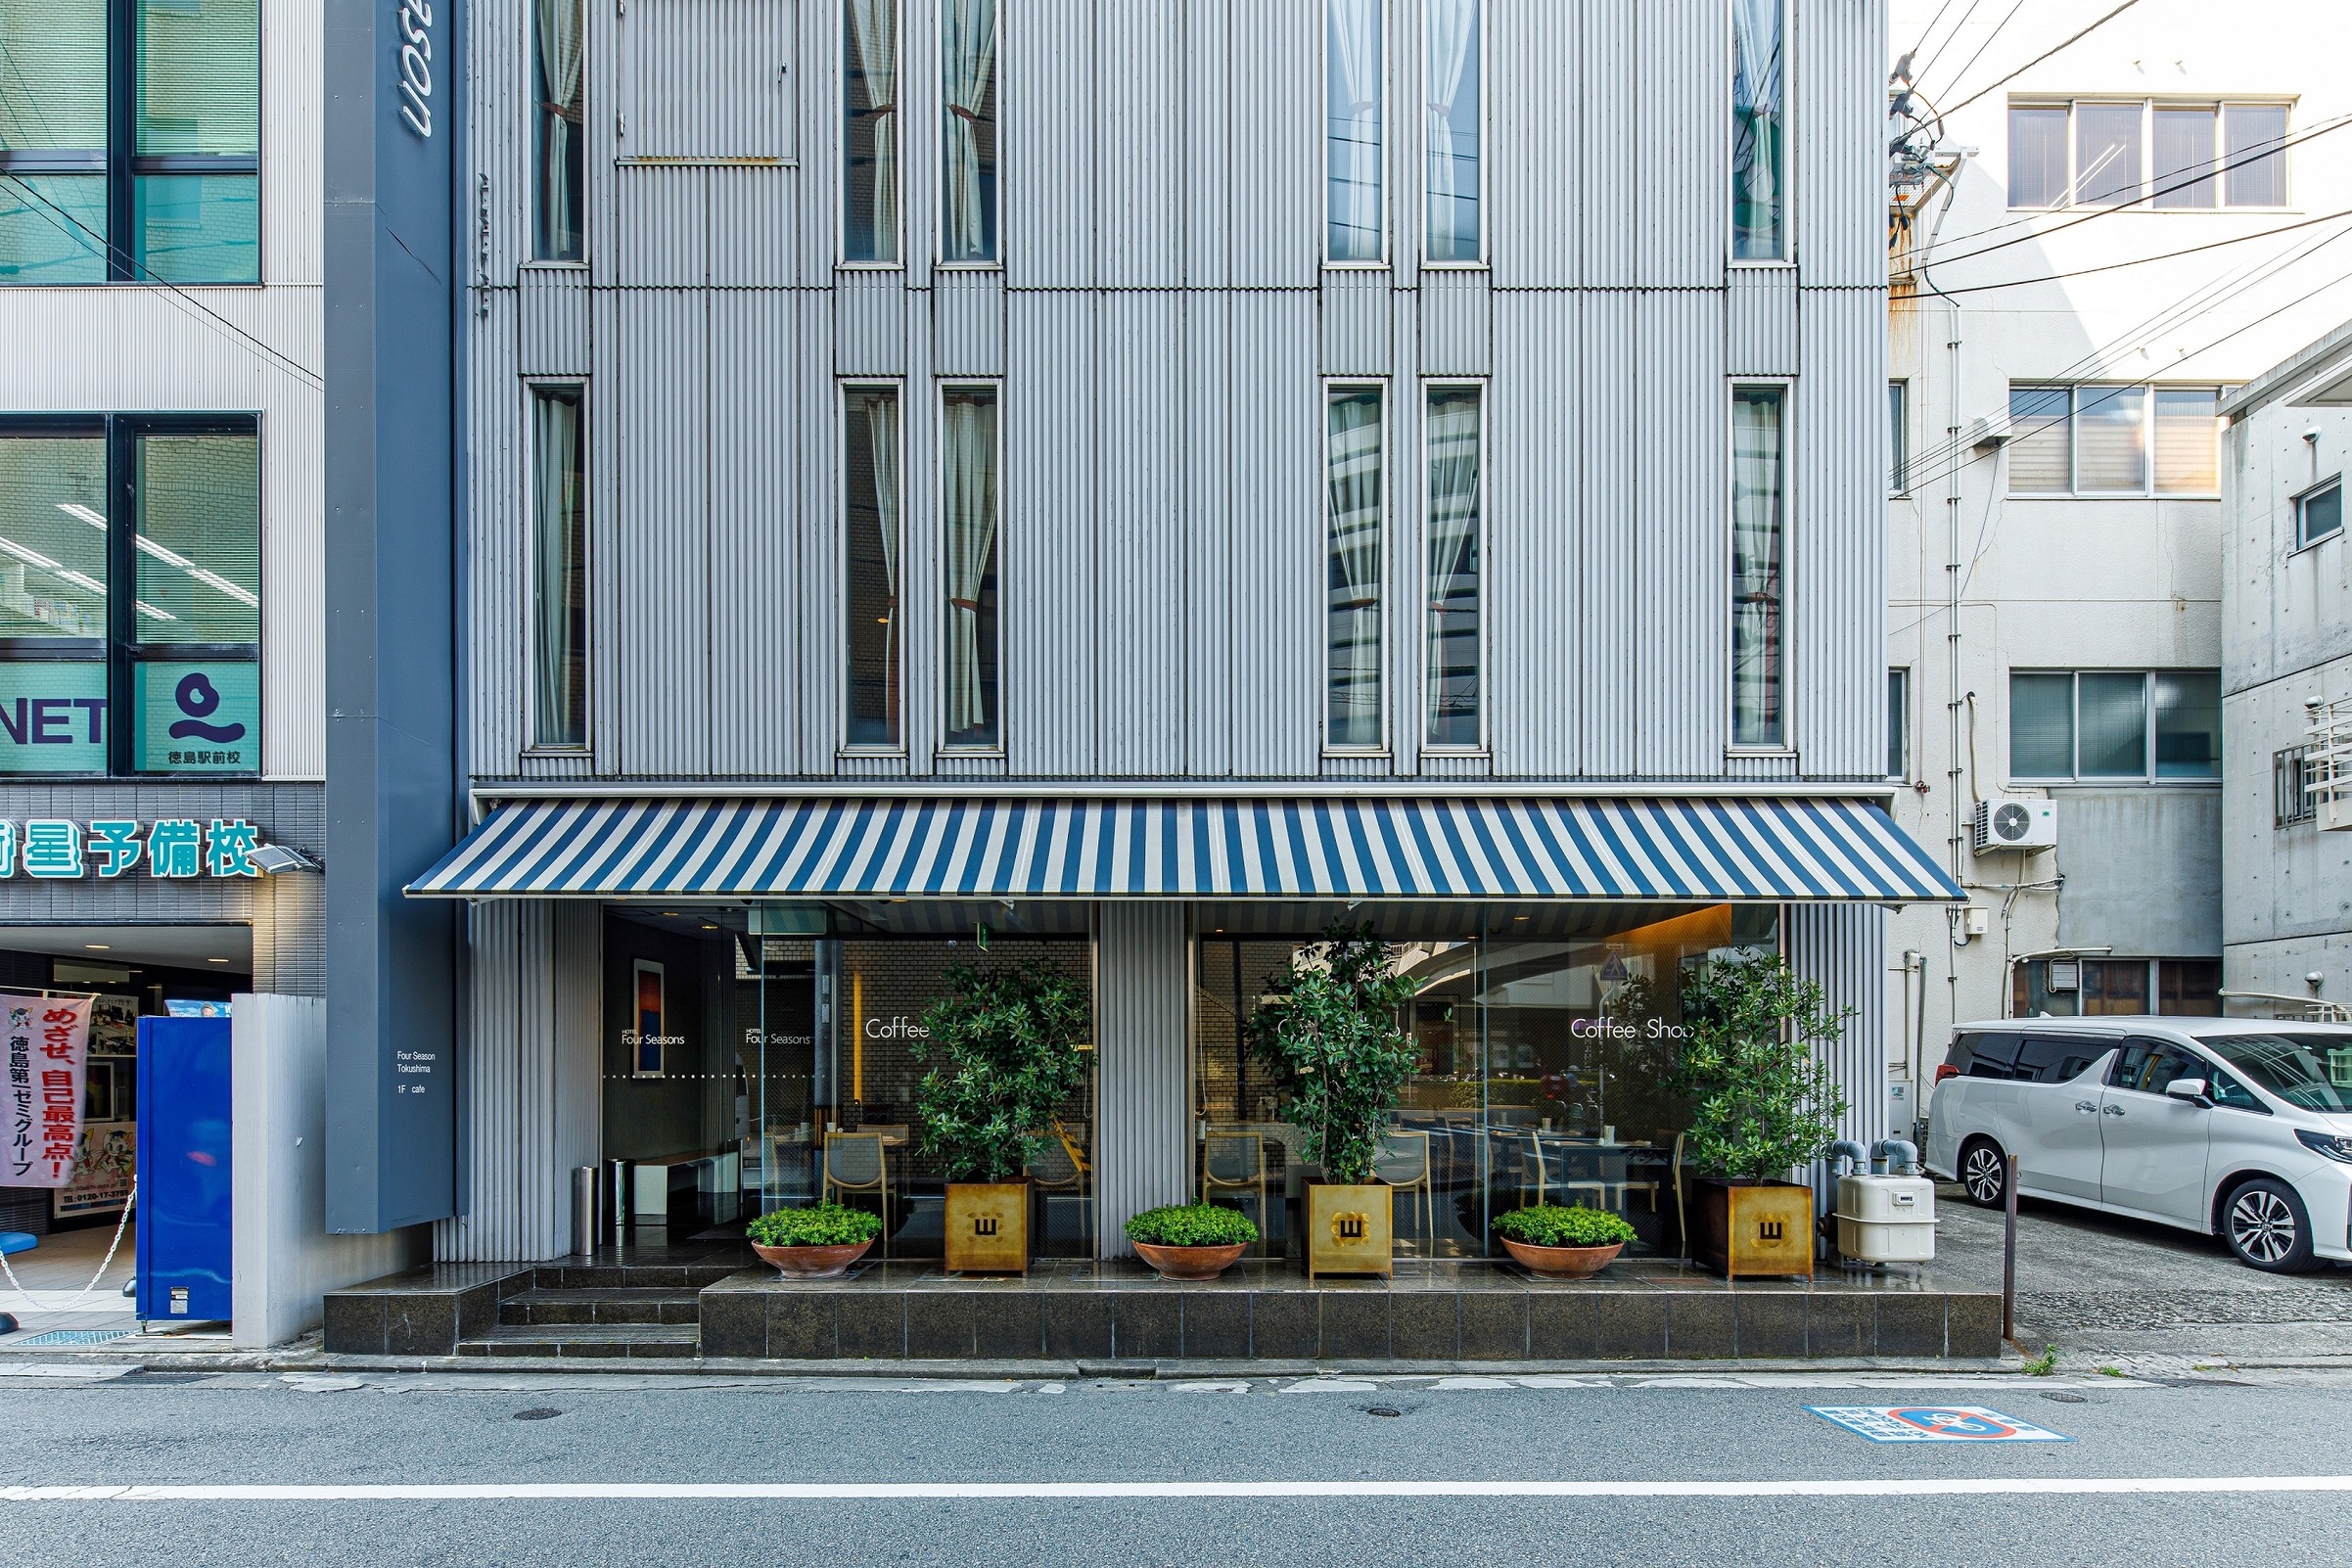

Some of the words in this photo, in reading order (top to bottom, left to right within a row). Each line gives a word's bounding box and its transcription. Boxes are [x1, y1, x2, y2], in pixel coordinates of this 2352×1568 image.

[168, 751, 242, 764] 徳島駅前校
[0, 818, 258, 879] 星予備校
[865, 1016, 930, 1038] Coffee
[1571, 1016, 1636, 1038] Coffee
[622, 1035, 643, 1044] Four
[645, 1034, 685, 1044] Seasons
[770, 1033, 811, 1044] Seasons
[396, 1050, 412, 1060] Four
[412, 1050, 436, 1061] Season
[396, 1063, 431, 1073] Tokushima
[397, 1084, 406, 1093] 1F
[10, 1036, 33, 1176] 徳島第一ゼミグループ
